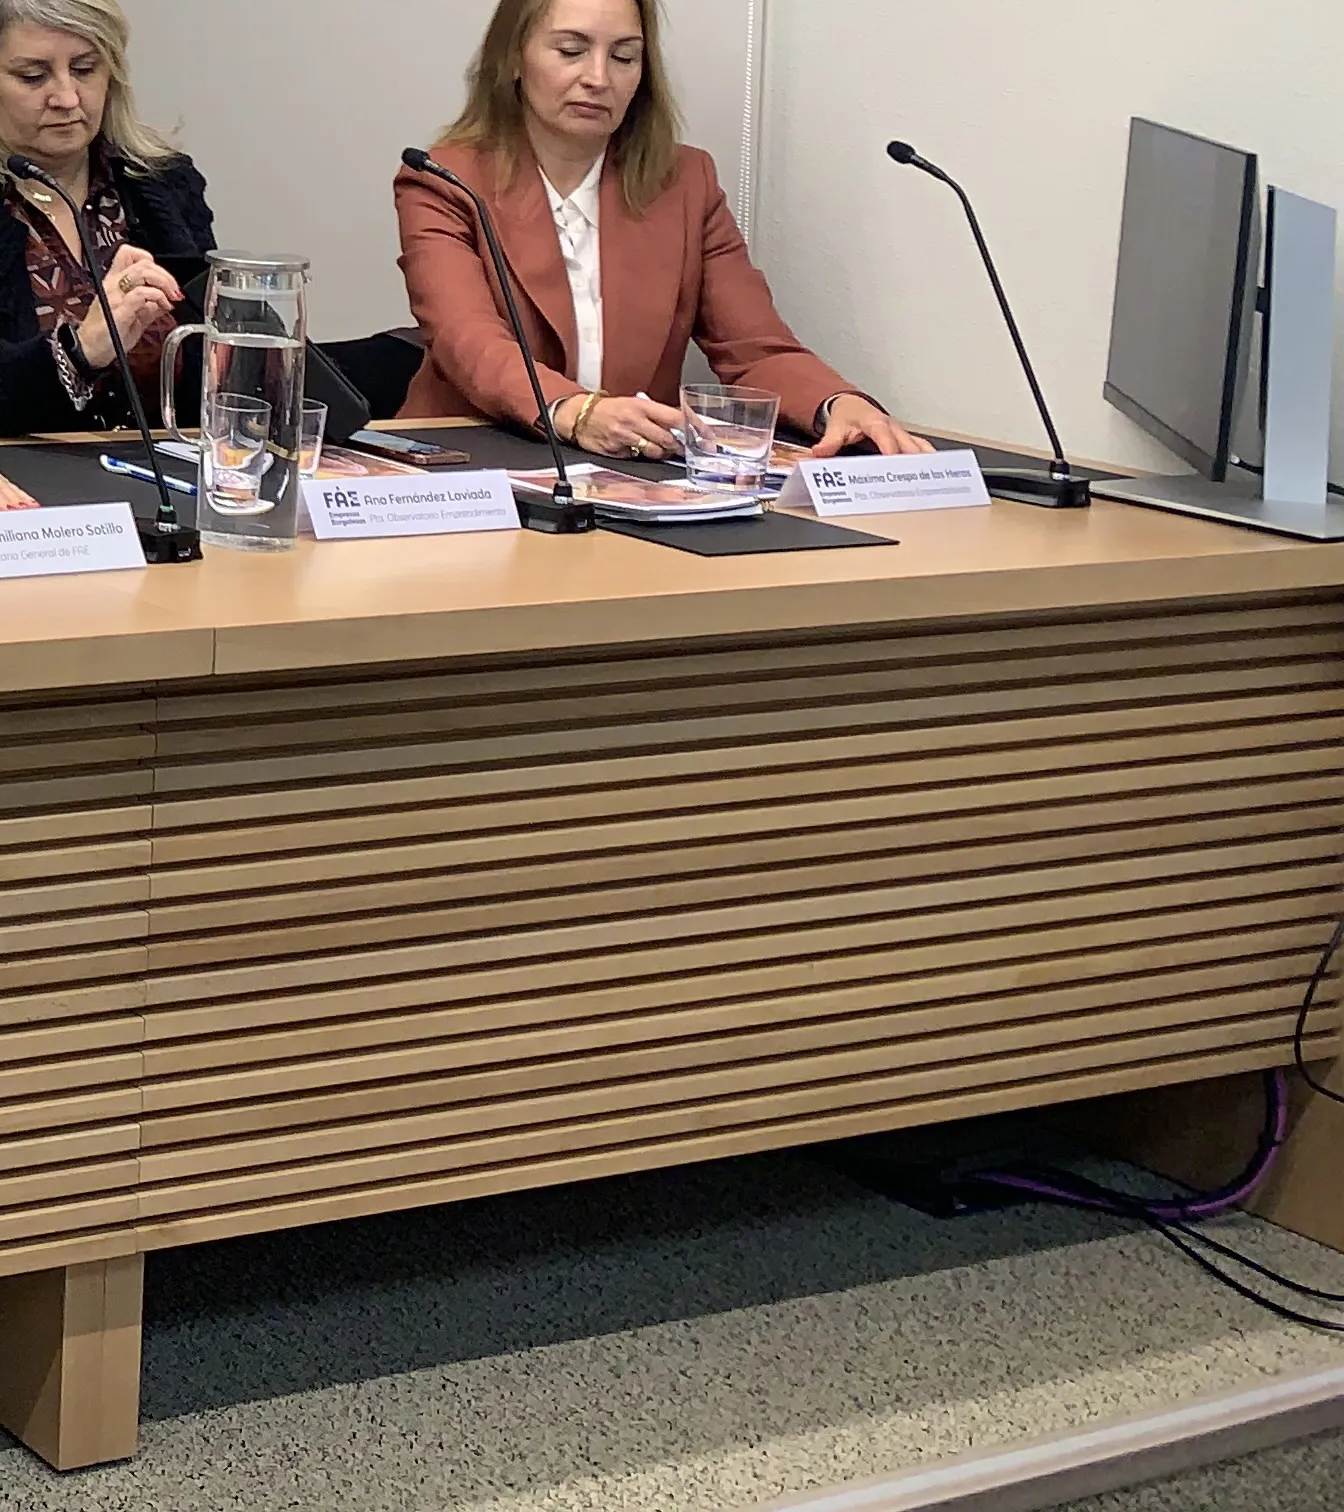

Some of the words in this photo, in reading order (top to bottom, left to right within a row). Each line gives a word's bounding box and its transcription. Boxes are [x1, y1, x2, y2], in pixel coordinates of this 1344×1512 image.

[364, 494, 387, 506] Ana
[389, 491, 447, 505] Fernández
[447, 488, 492, 502] Laviada
[42, 525, 84, 539] Molero
[85, 522, 124, 536] Sotillo
[21, 547, 57, 561] General
[58, 547, 71, 558] de
